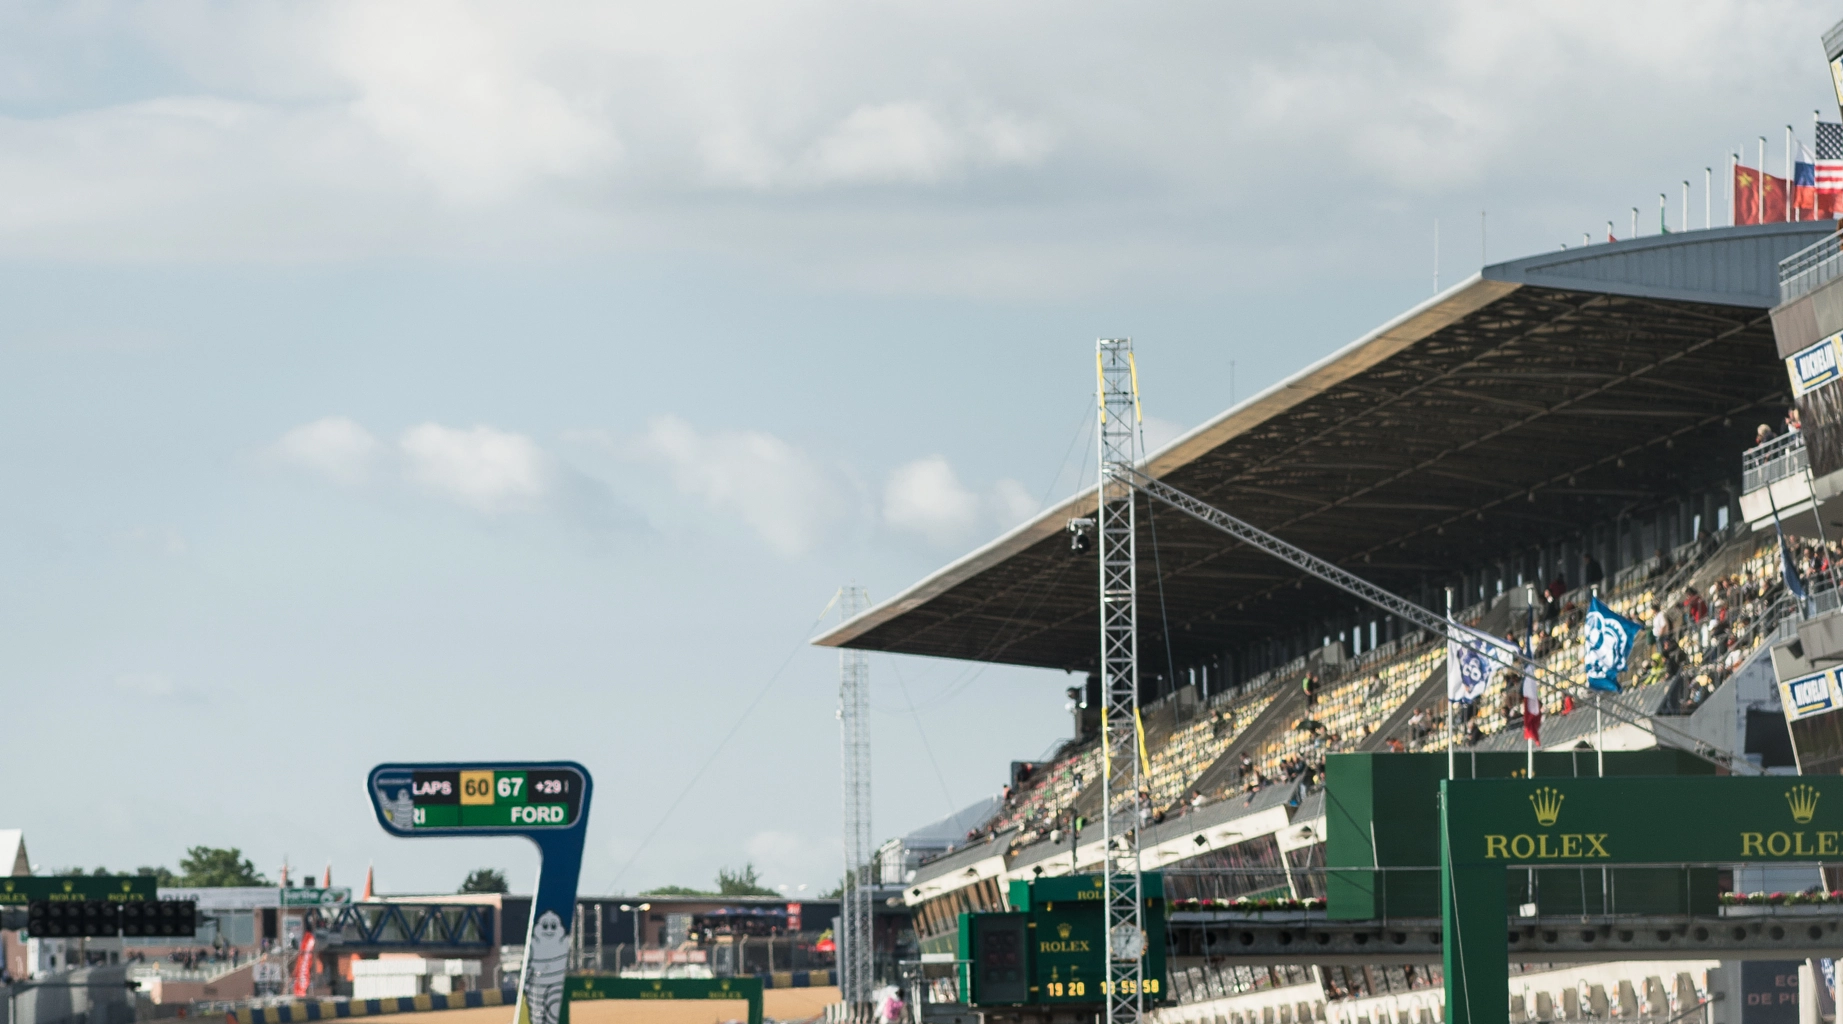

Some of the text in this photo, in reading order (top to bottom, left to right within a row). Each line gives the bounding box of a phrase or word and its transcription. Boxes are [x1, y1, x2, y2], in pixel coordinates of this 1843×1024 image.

[412, 780, 452, 796] LAPS
[464, 778, 489, 797] 60
[497, 778, 524, 797] 67
[511, 807, 564, 823] FORD
[1484, 834, 1611, 859] ROLEX
[1740, 832, 1843, 856] ROLE
[1077, 890, 1119, 900] ROLX
[1040, 940, 1090, 953] ROLEX
[1047, 982, 1064, 997] 19
[1068, 981, 1085, 997] 20
[1747, 992, 1799, 1006] DE PI
